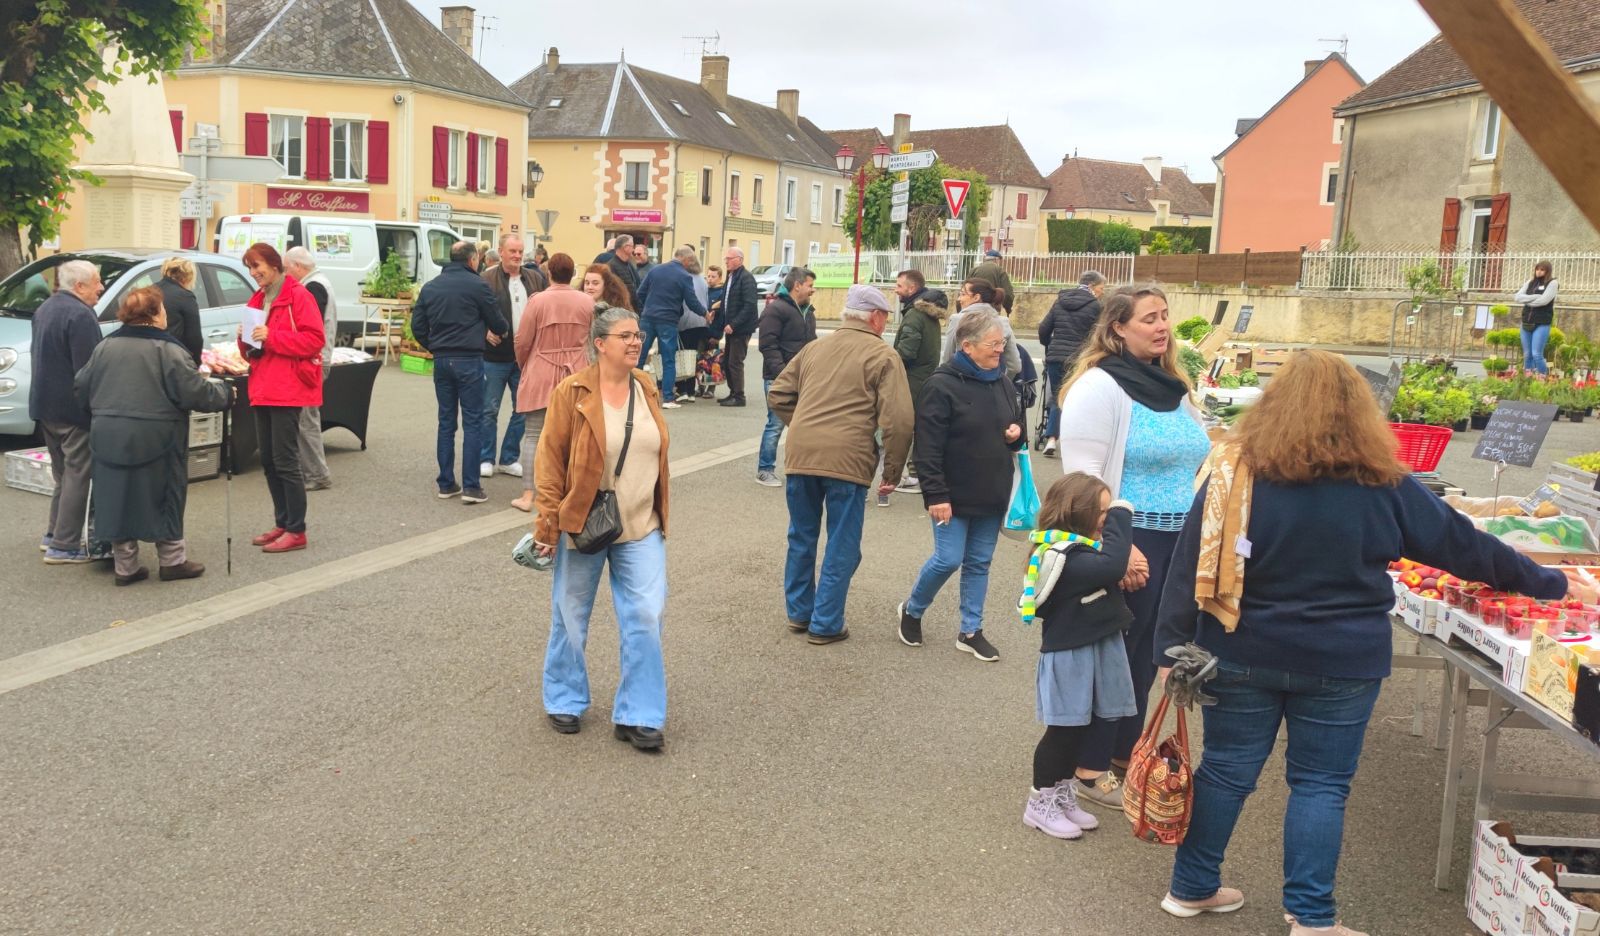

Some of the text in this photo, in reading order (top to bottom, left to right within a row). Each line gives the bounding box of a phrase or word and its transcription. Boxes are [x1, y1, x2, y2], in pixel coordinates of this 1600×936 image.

[307, 193, 359, 212] Coiffure
[1406, 602, 1421, 616] Vallée
[1521, 871, 1572, 923] Réart Vallée
